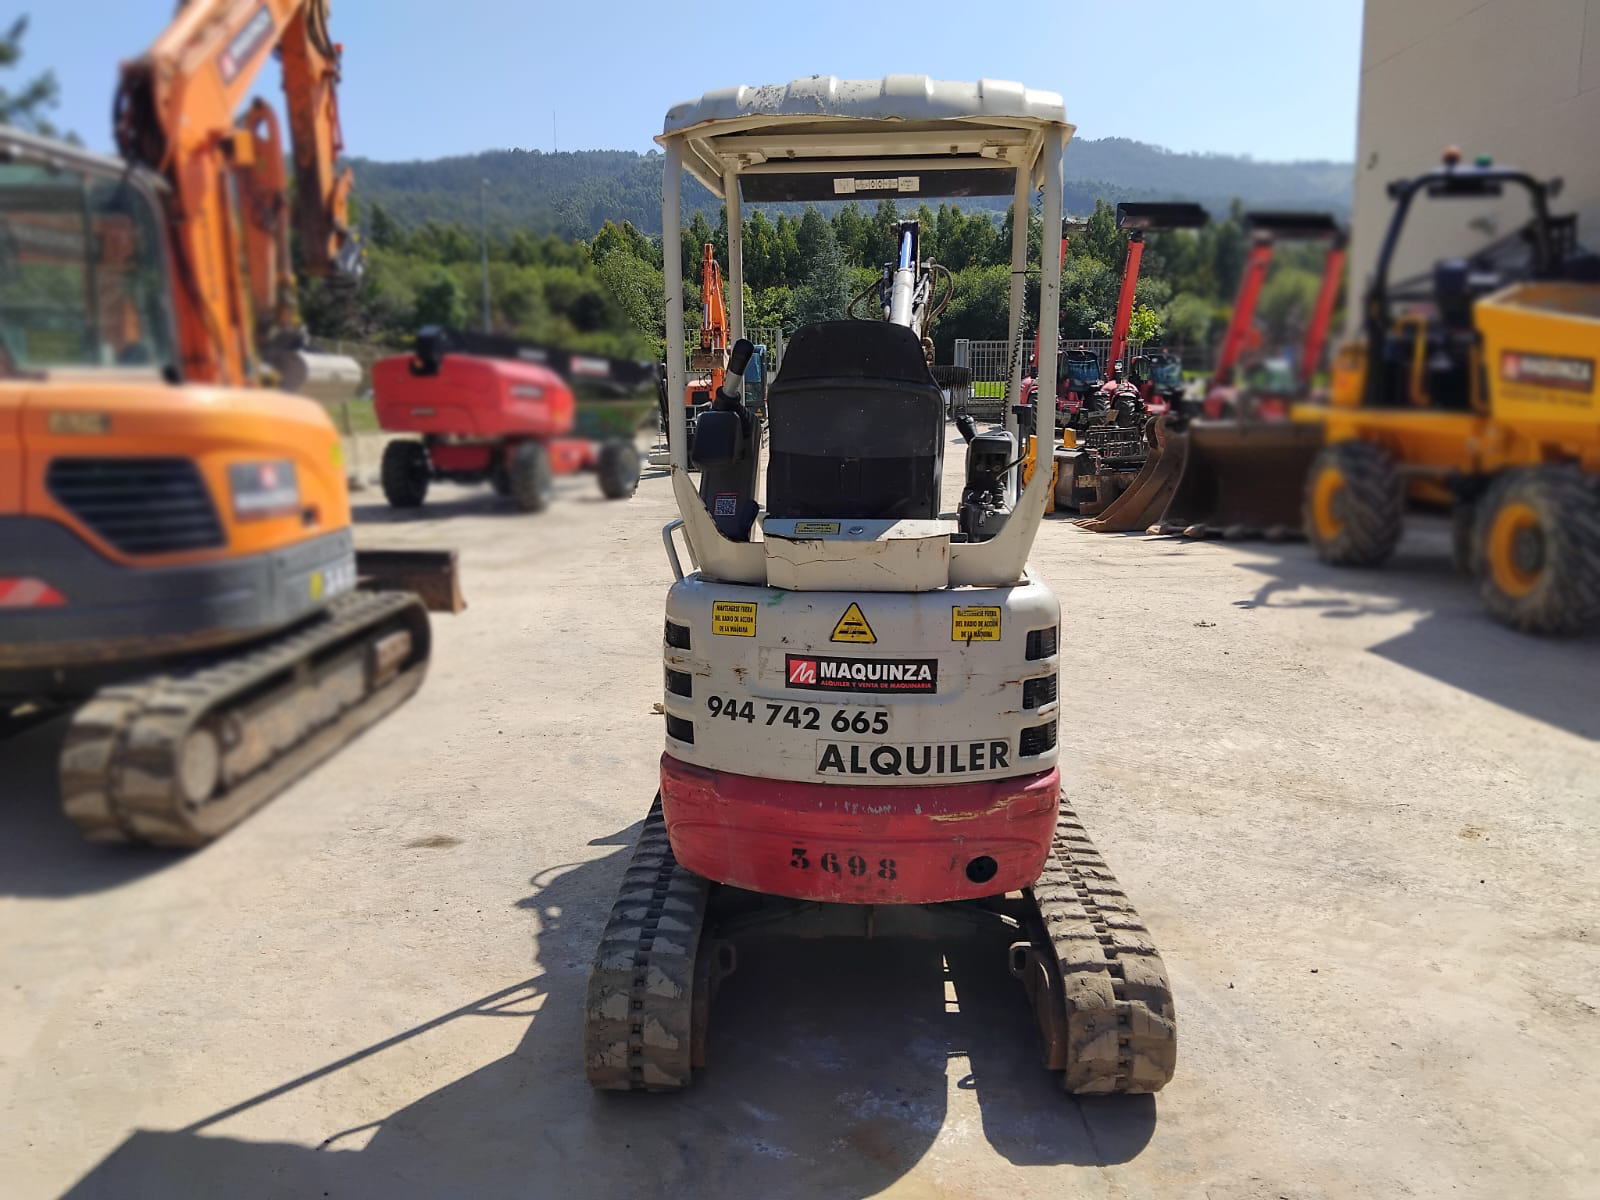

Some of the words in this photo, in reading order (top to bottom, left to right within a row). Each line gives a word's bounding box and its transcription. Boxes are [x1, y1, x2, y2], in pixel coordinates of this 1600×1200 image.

[820, 661, 932, 681] MAQUINZA
[820, 680, 850, 688] ALQUILER
[707, 695, 756, 724] 944
[765, 703, 820, 731] 742
[831, 709, 889, 735] 665
[817, 741, 1010, 776] ALQUILER
